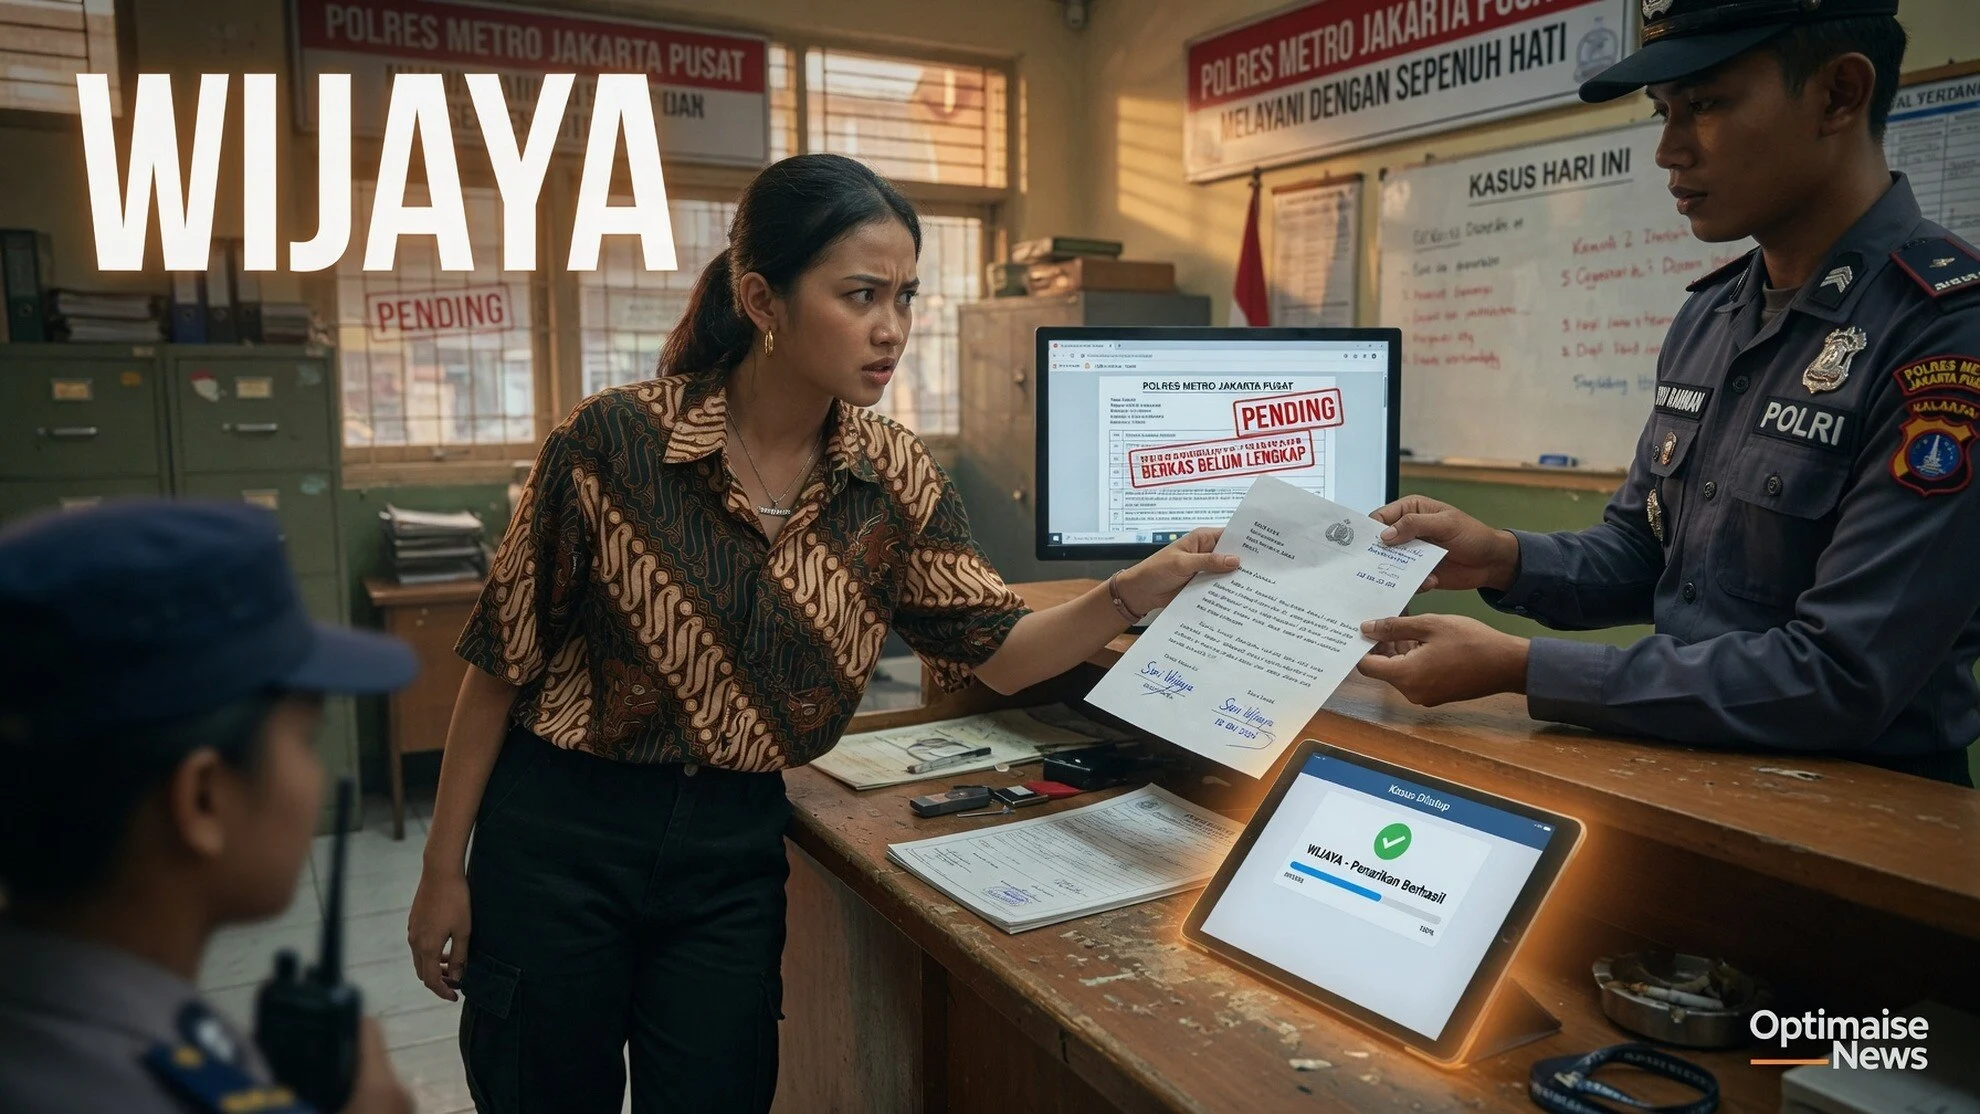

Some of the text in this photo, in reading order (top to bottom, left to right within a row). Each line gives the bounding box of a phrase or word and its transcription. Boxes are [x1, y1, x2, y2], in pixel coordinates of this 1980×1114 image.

[326, 4, 745, 82] POLRES METRO JAKARTA PUSAT
[1201, 0, 1470, 100] POLRES METRO JAKARTA
[1220, 22, 1567, 143] MELAYANI DENGAN SEPENUH HATI
[1469, 148, 1631, 199] KASUS HARI INI
[377, 293, 504, 333] PENDING
[1142, 381, 1181, 391] POLRES
[1182, 381, 1216, 391] METRO
[1241, 396, 1336, 431] PENDING
[1759, 401, 1845, 446] POLRI
[1141, 460, 1195, 479] BERKAS
[1199, 453, 1243, 473] BELUM
[1246, 445, 1306, 466] LENGKAP
[1306, 843, 1344, 867] WIJAYA
